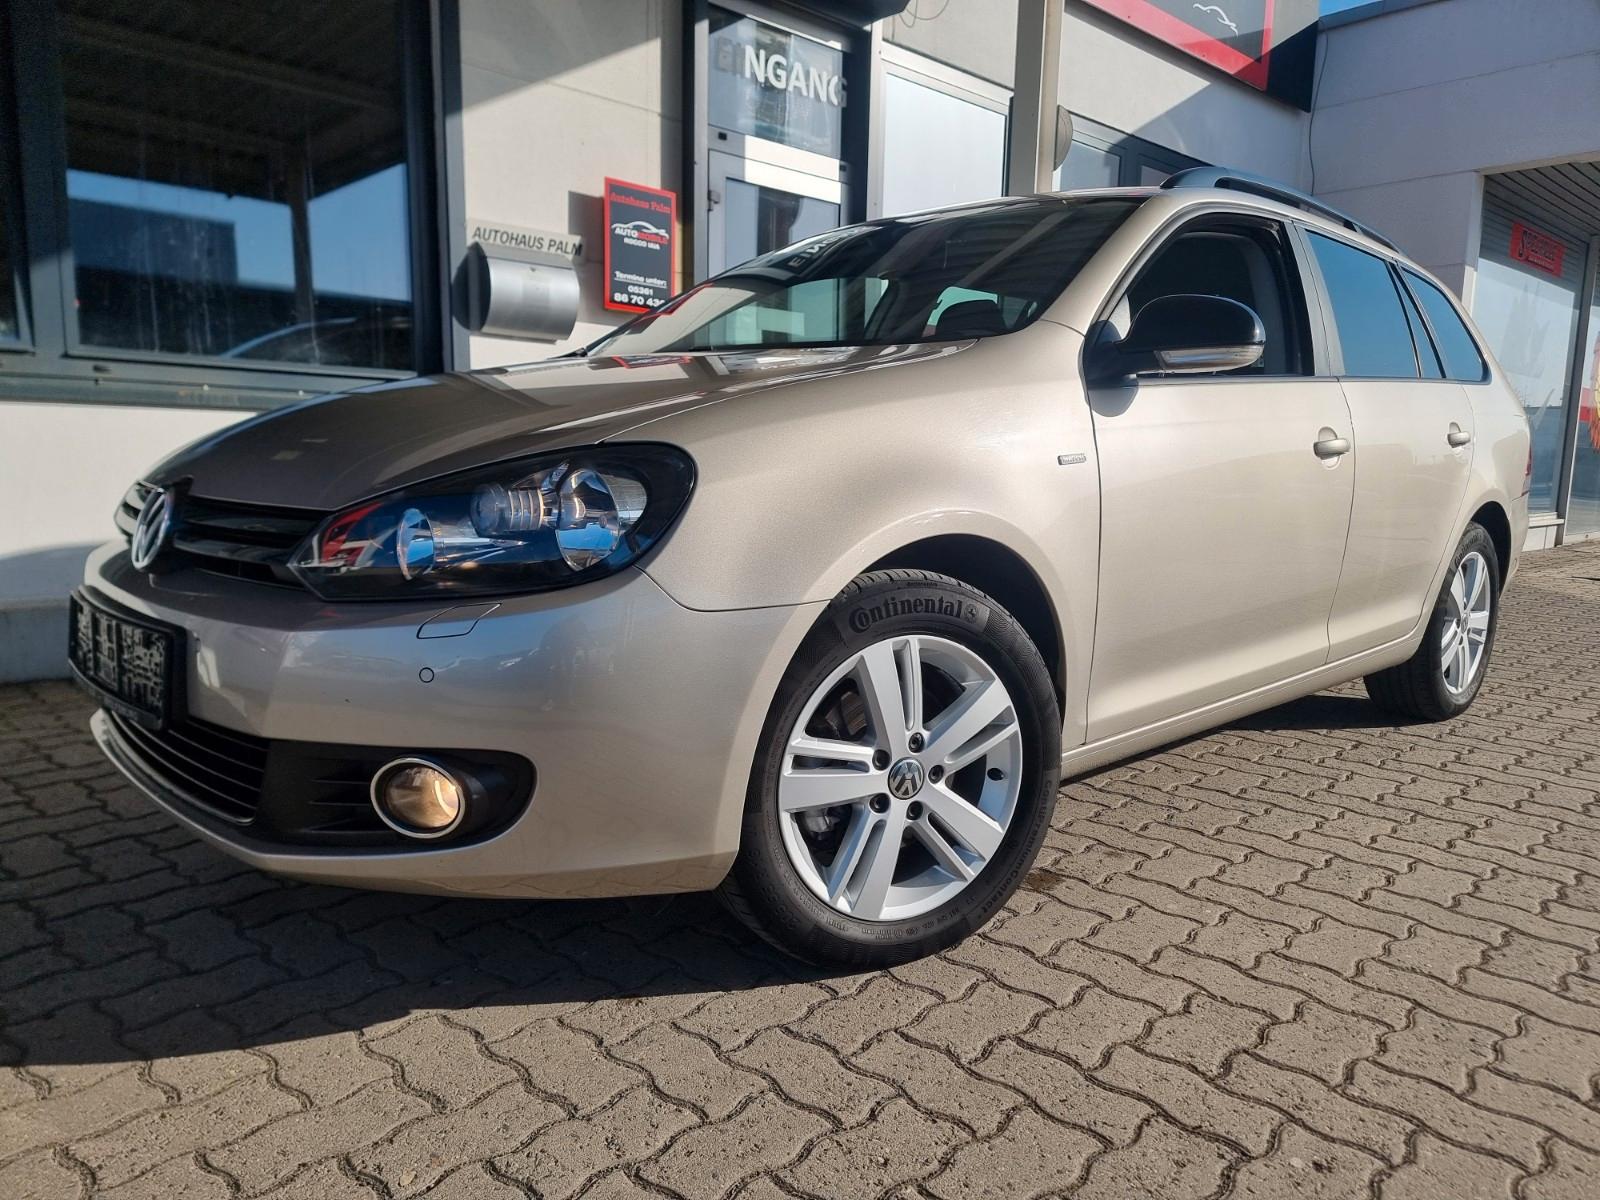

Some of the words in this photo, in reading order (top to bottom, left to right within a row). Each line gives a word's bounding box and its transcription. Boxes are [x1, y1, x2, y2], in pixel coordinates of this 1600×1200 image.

[472, 226, 545, 250] AUTOHAUS
[547, 237, 583, 257] PALM
[614, 271, 645, 282] Termine
[630, 294, 645, 305] 70
[849, 596, 963, 634] Continental
